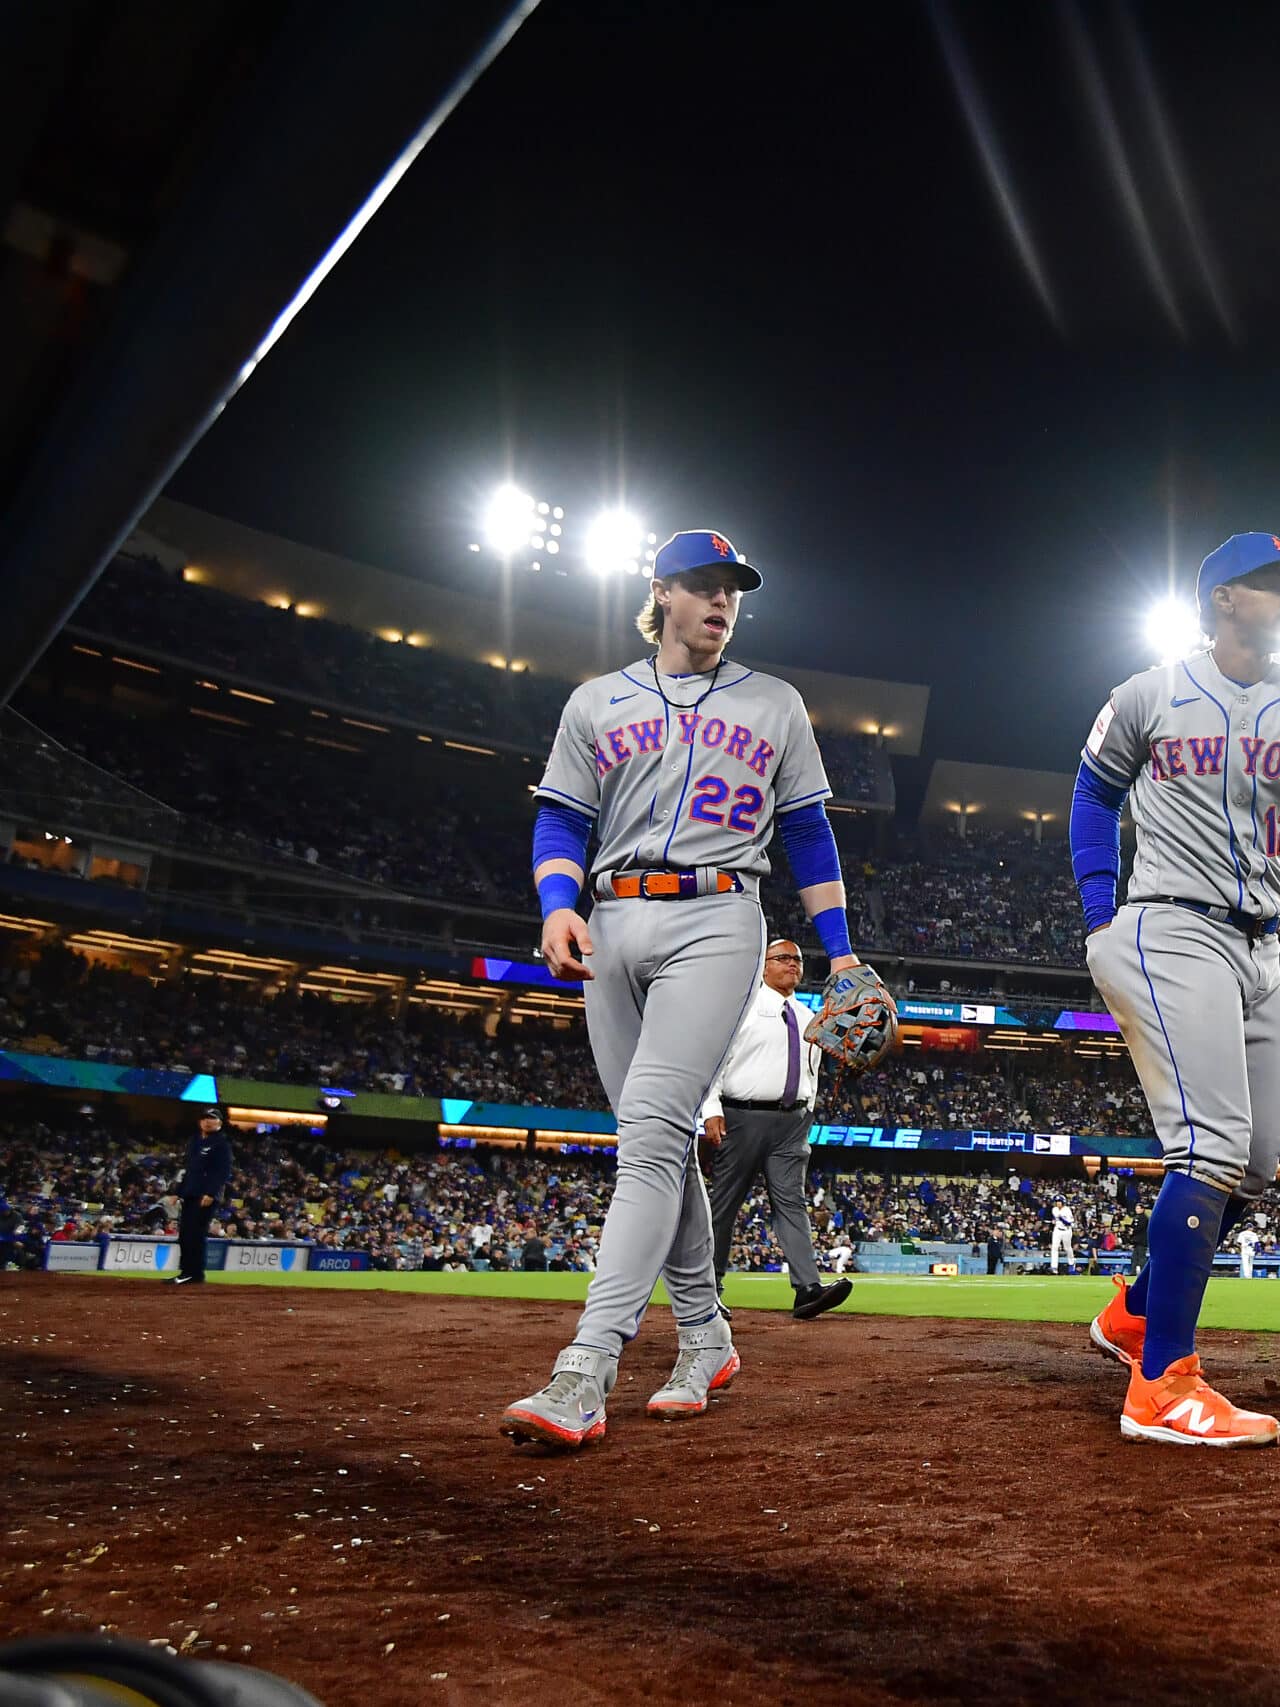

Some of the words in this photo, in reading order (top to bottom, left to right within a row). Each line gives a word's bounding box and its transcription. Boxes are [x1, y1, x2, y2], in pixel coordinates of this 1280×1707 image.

[677, 714, 775, 777] YORK
[688, 774, 765, 834] 22
[114, 1243, 153, 1263] blue
[240, 1247, 279, 1266] blue
[319, 1258, 351, 1270] ARCO
